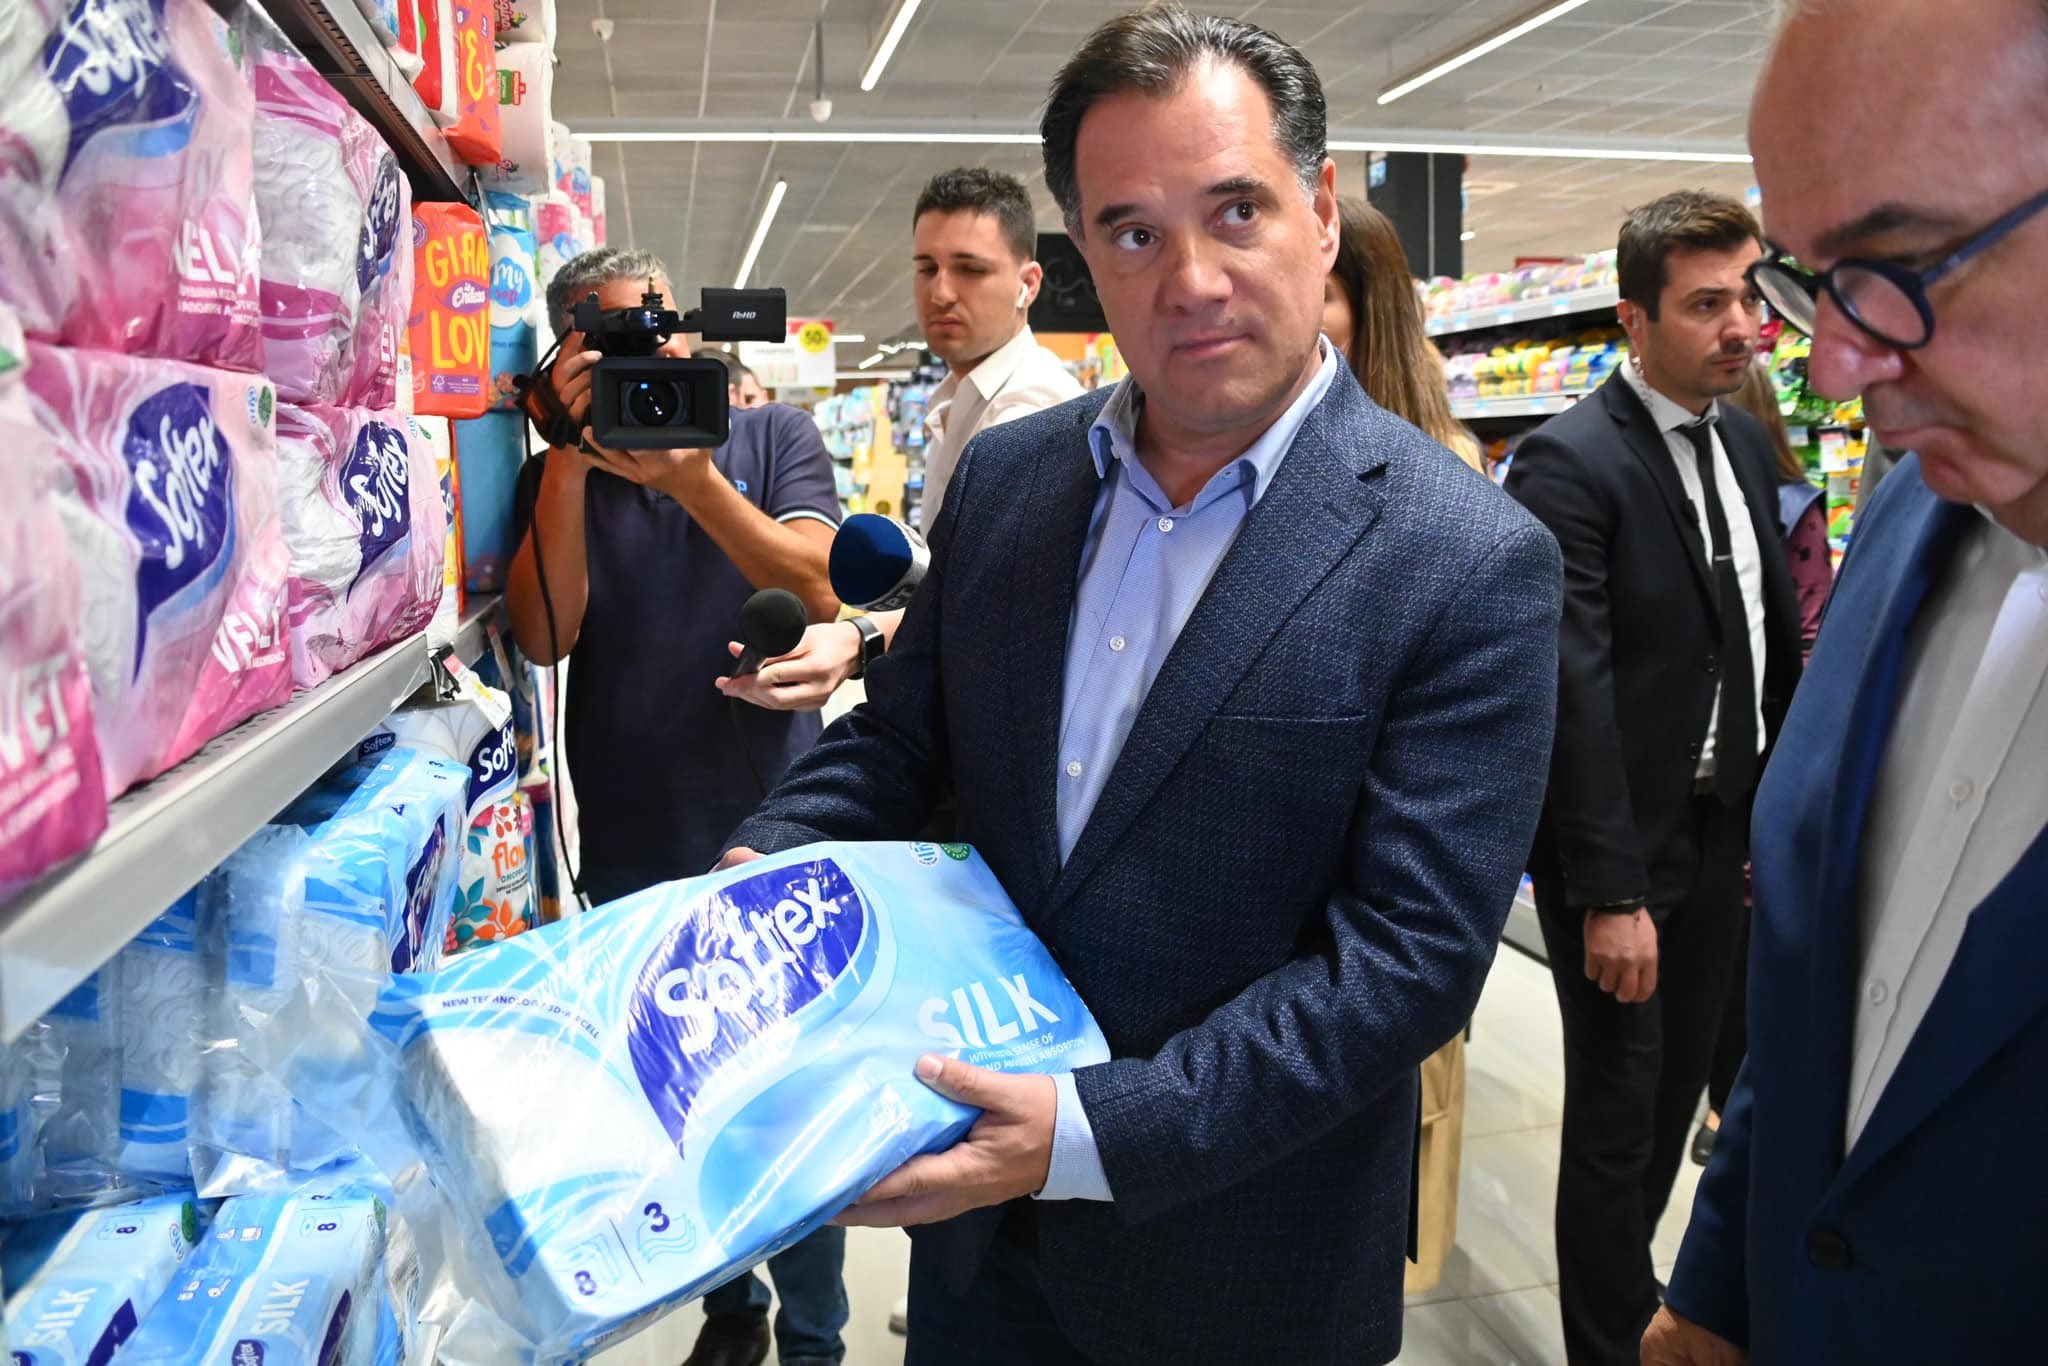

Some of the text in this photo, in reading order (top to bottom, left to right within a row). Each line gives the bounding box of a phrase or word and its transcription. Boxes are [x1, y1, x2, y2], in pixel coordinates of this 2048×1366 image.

[425, 231, 490, 288] GIAN
[430, 310, 491, 370] LOV
[135, 414, 219, 570] Softex
[363, 735, 393, 753] Softex
[654, 877, 841, 1055] Softex
[442, 995, 469, 1008] NEW
[918, 973, 1061, 1050] SILK
[1042, 1032, 1054, 1045] OF
[317, 1222, 337, 1231] 8
[643, 1201, 670, 1233] 3
[250, 1279, 311, 1336] SILK
[574, 1270, 597, 1296] 8
[23, 1287, 98, 1347] SILK
